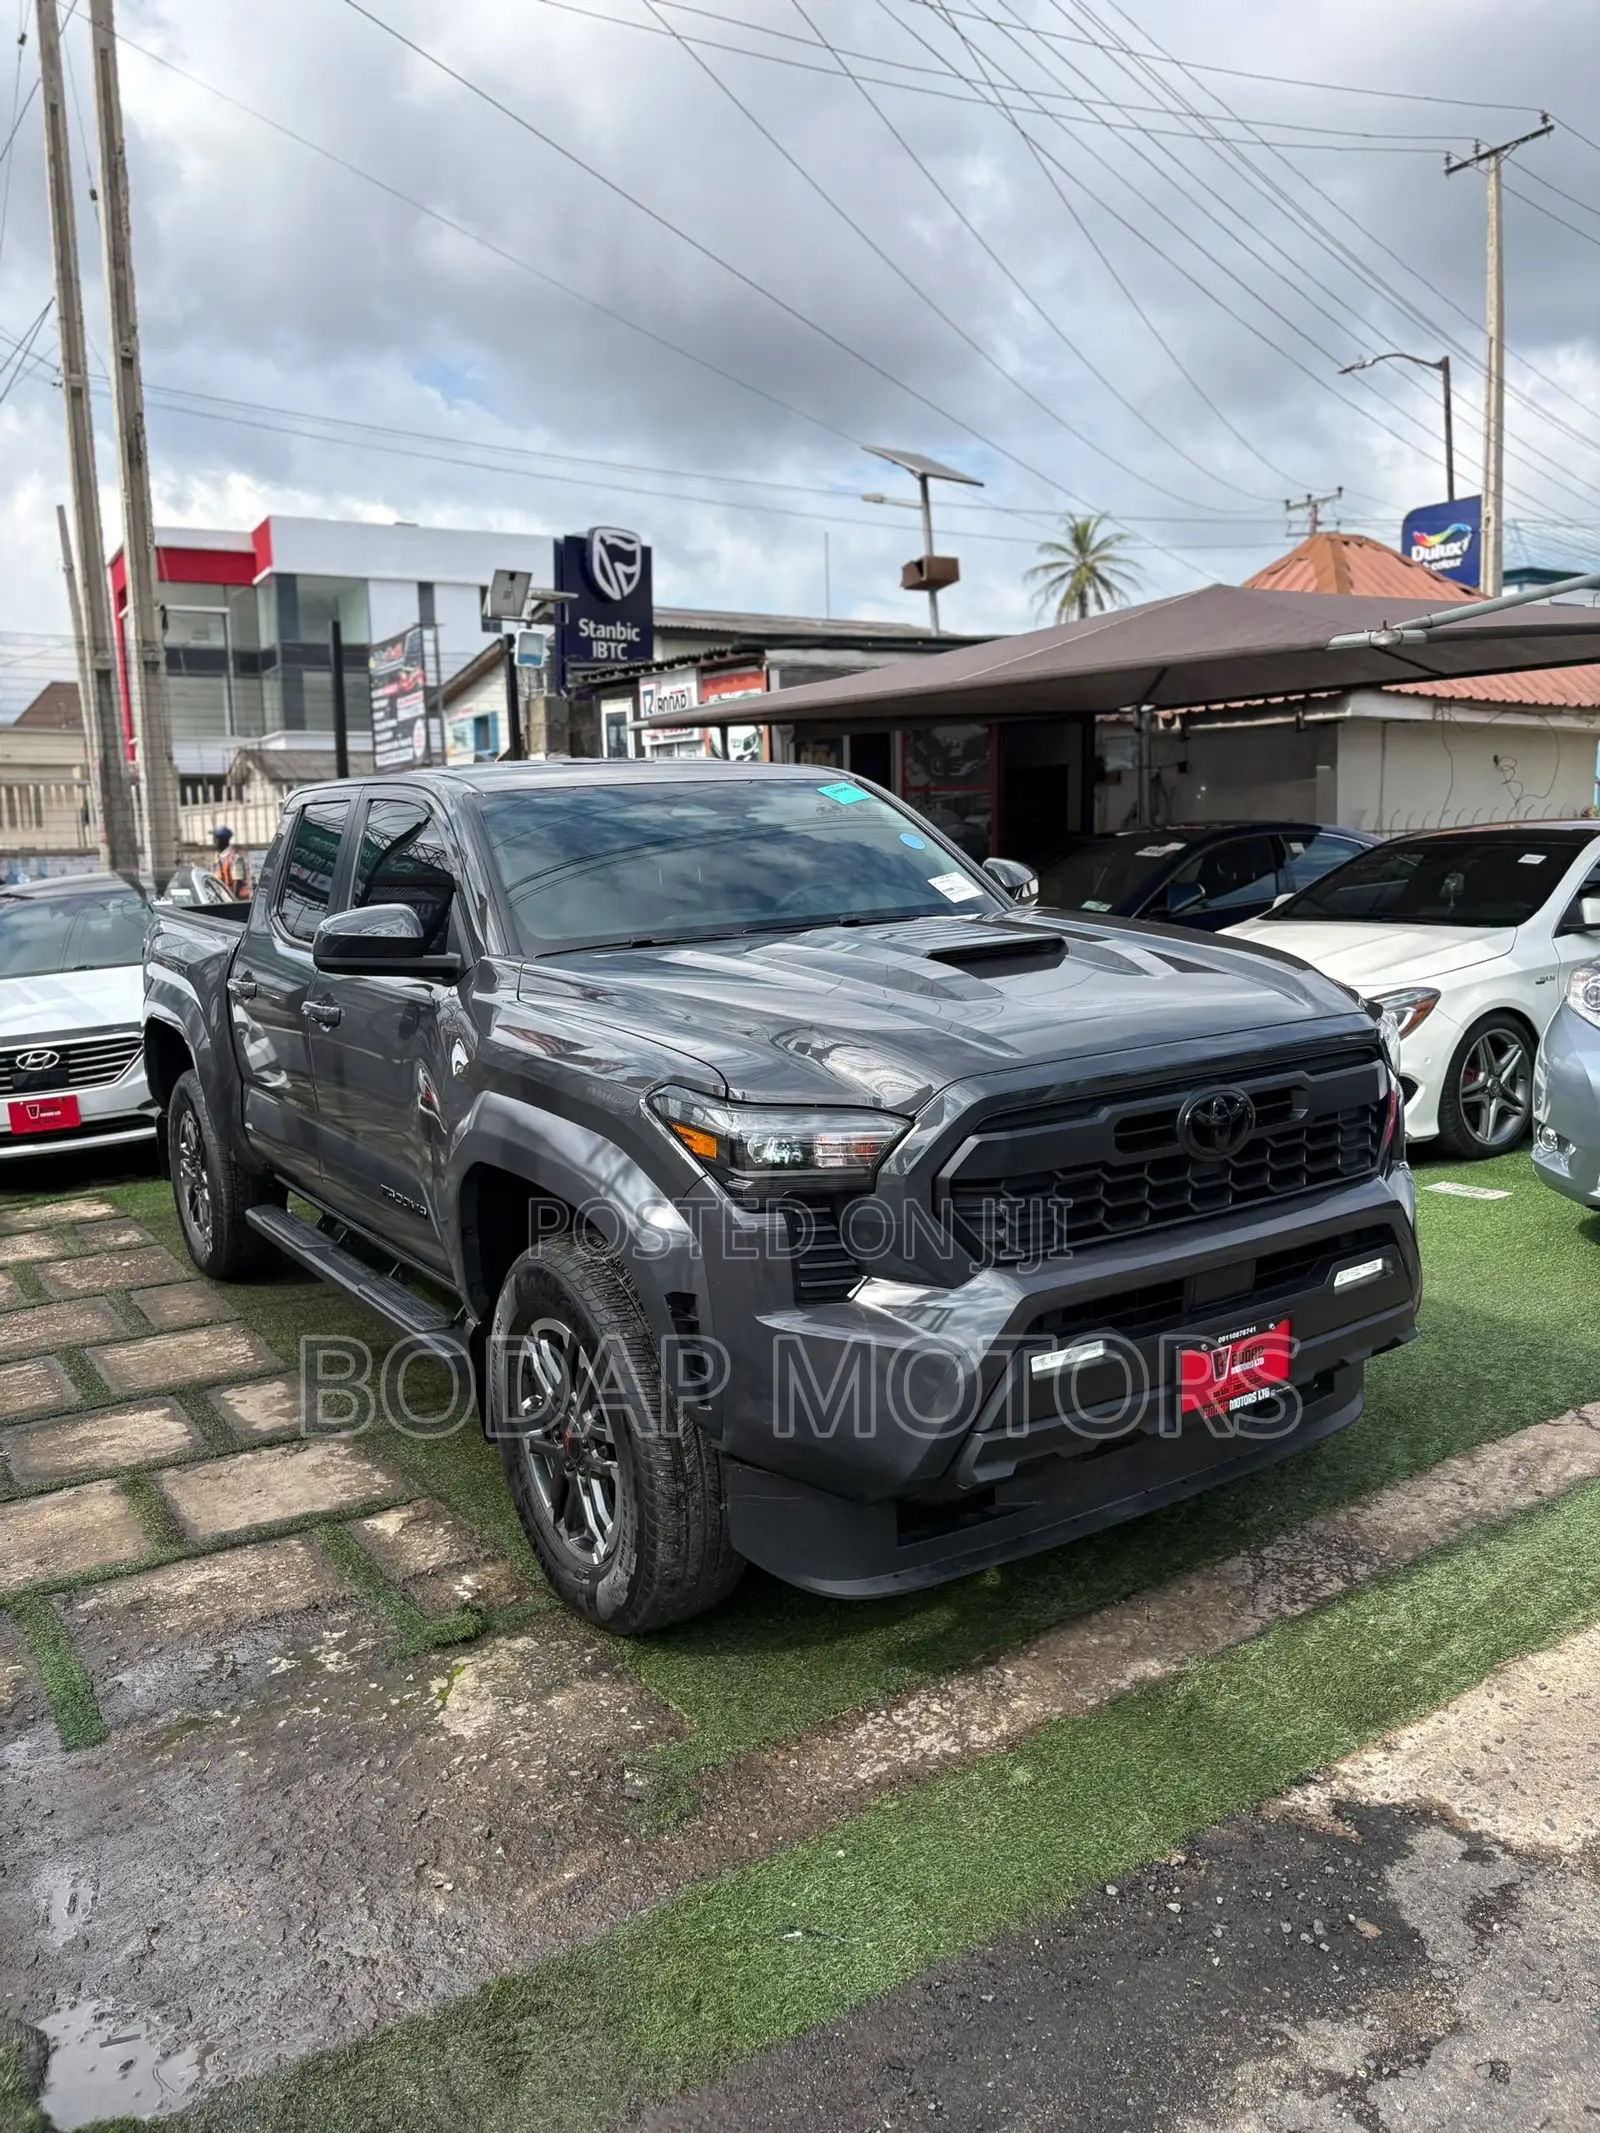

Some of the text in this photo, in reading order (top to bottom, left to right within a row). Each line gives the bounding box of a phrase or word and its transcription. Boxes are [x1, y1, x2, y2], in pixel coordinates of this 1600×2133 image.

[1411, 536, 1472, 562] Dulux
[578, 618, 641, 642] Stanbic
[592, 640, 628, 660] IBTC
[1229, 1391, 1257, 1411] MOTORS
[1257, 1387, 1270, 1401] LTD
